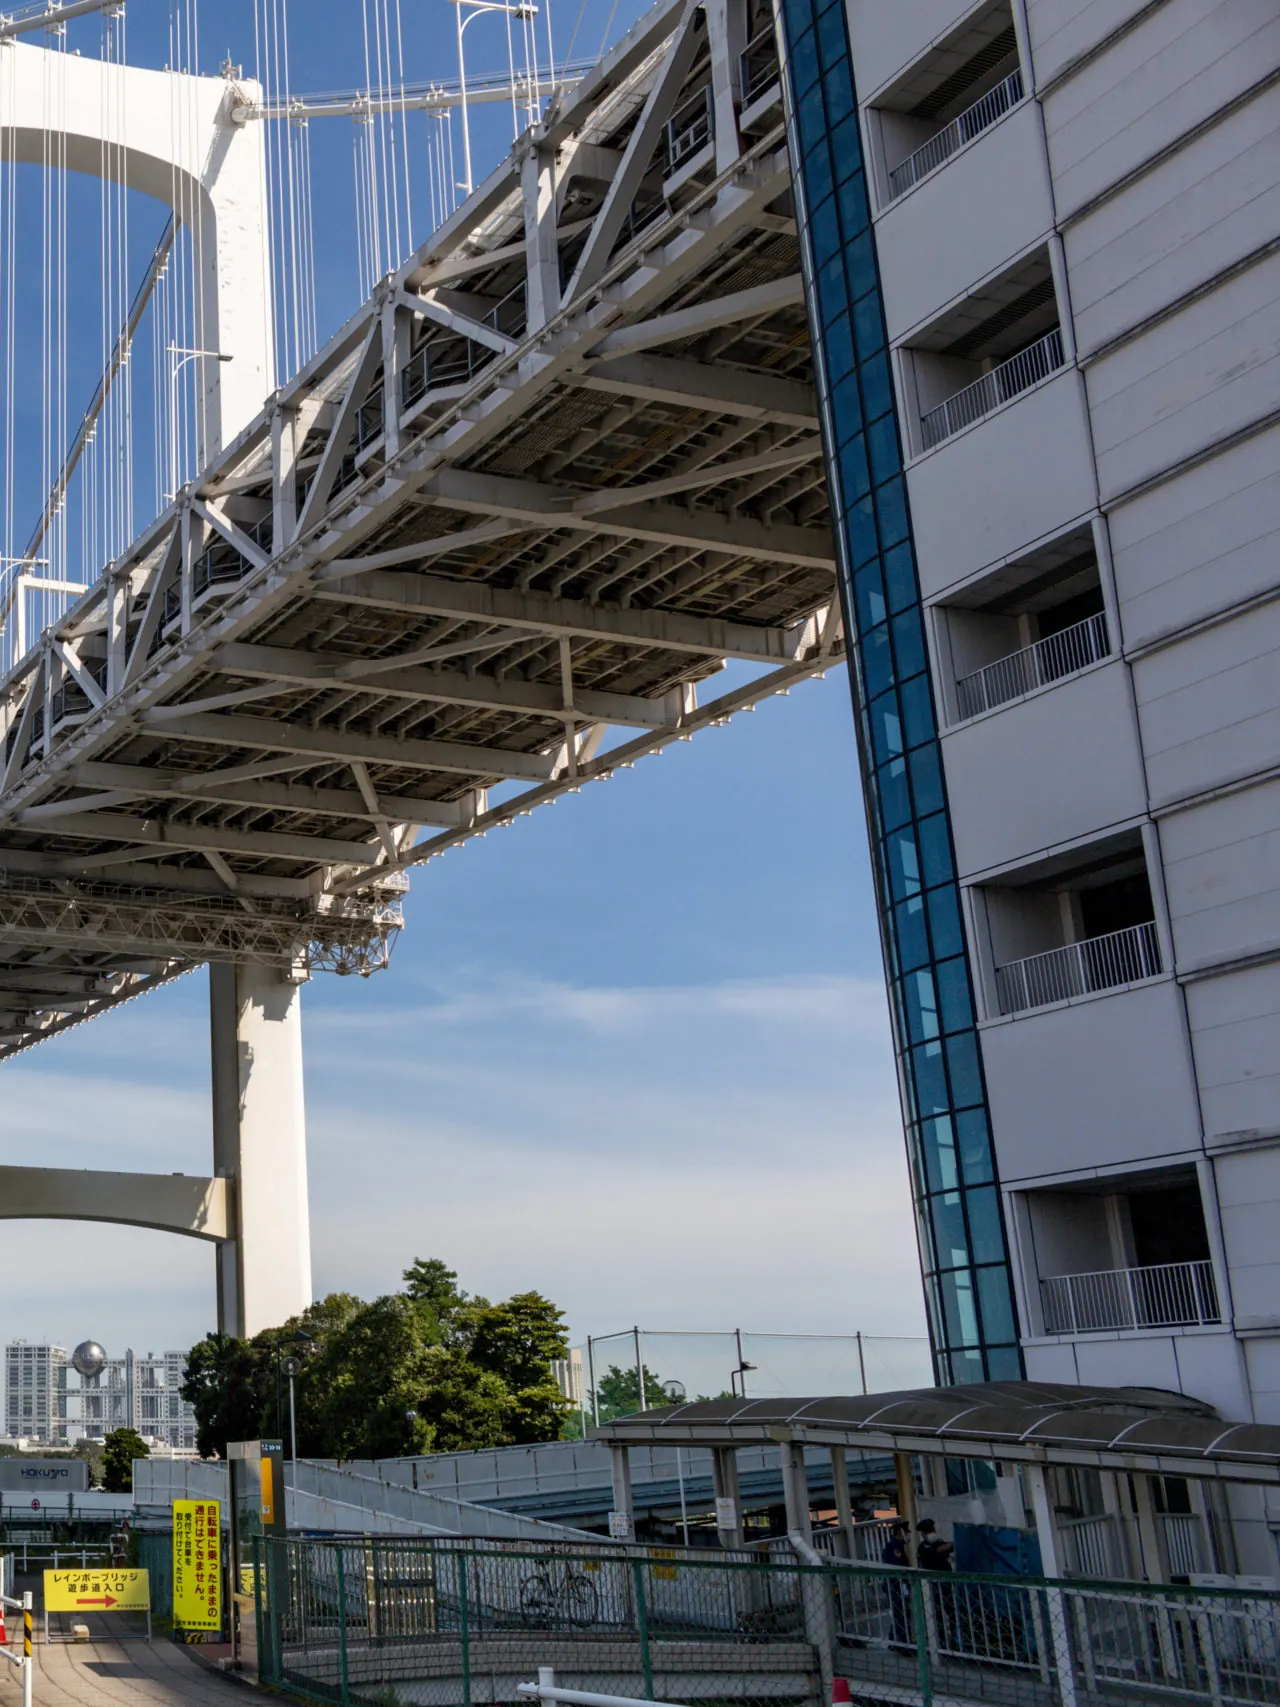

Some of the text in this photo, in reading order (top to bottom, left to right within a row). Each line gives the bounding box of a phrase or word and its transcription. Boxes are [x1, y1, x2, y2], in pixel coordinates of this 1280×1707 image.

[21, 1468, 69, 1479] HOKUYO
[194, 1505, 205, 1601] 通行はできません。
[207, 1505, 218, 1617] 自転車に乗ったままの
[53, 1572, 138, 1583] レインボーブリッジ
[67, 1583, 124, 1593] 遊歩道入口
